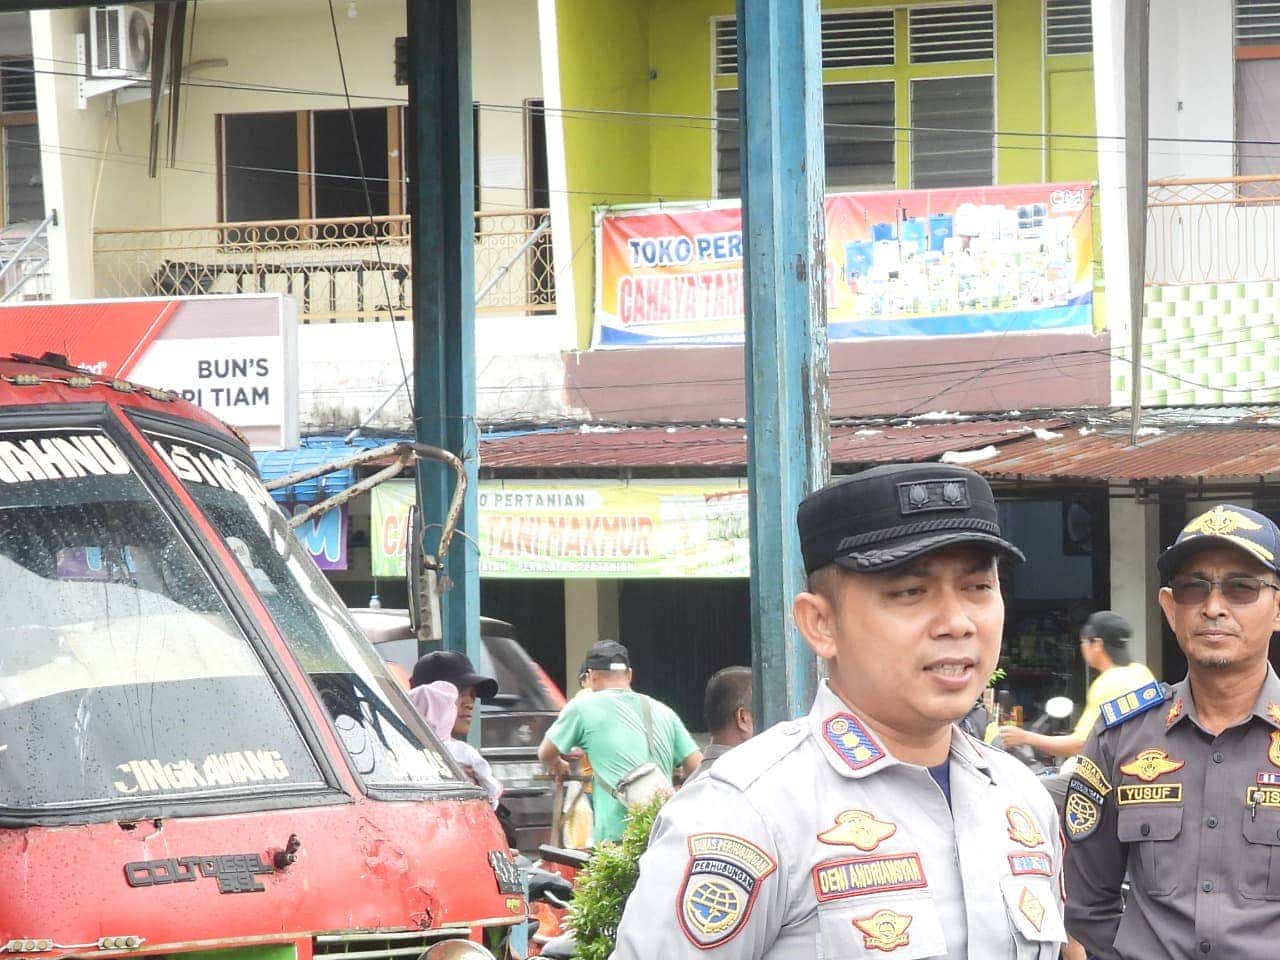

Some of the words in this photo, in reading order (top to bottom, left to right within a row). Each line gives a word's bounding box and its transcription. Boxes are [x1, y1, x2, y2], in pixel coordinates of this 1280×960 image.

[630, 238, 691, 264] TOKO
[697, 233, 743, 259] PER
[620, 273, 698, 324] CAHAYA
[198, 358, 269, 379] BUN'S
[210, 387, 269, 406] TIAM
[494, 494, 586, 507] PERTANIAN
[1125, 787, 1172, 800] YUSUF
[820, 866, 849, 893] DENI
